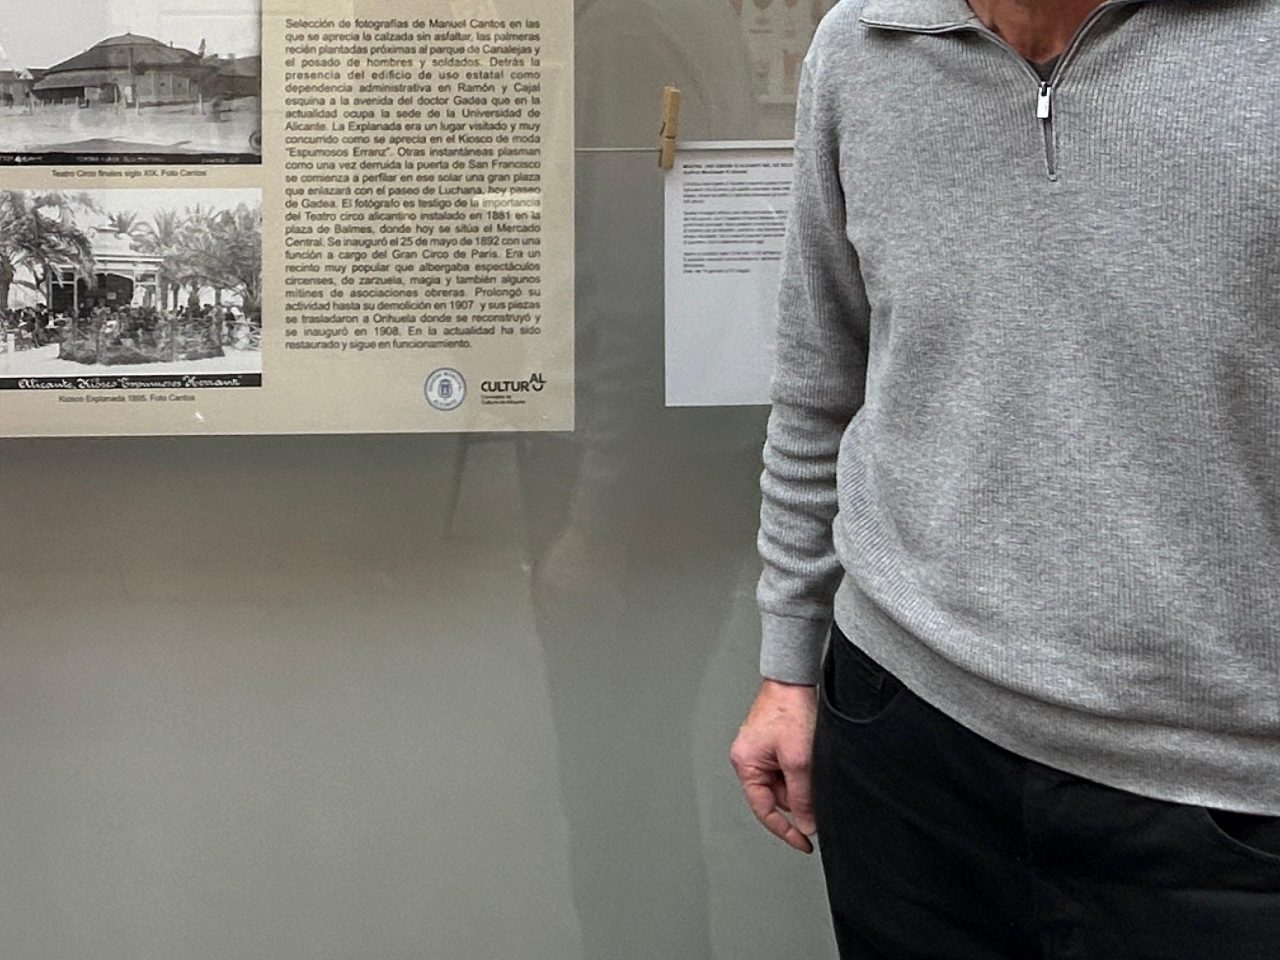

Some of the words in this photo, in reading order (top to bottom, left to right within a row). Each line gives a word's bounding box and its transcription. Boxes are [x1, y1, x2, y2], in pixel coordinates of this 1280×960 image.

[286, 19, 334, 28] Selección
[338, 19, 351, 28] de
[355, 19, 408, 31] fotografías
[412, 19, 425, 28] de
[429, 19, 466, 28] Manuel
[470, 19, 506, 28] Cantos
[525, 19, 540, 28] las
[286, 34, 304, 43] que
[322, 32, 360, 43] aprecia
[362, 32, 372, 41] la
[374, 32, 414, 41] calzada
[416, 32, 431, 41] sin
[476, 32, 491, 41] las
[494, 32, 540, 43] palmeras
[286, 58, 295, 67] el
[301, 58, 340, 69] posado
[346, 58, 360, 67] de
[366, 58, 413, 67] hombres
[419, 59, 426, 69] y
[489, 58, 524, 66] Detrás
[530, 57, 540, 66] la
[286, 71, 340, 82] presencia
[347, 71, 364, 79] del
[371, 70, 412, 79] edificio
[418, 70, 432, 79] de
[466, 70, 504, 79] estatal
[286, 83, 352, 95] dependencia
[359, 83, 431, 92] administrativa
[458, 83, 495, 92] Ramón
[502, 85, 508, 94] y
[513, 83, 540, 94] Cajal
[286, 109, 337, 118] actualidad
[343, 111, 375, 120] ocupa
[381, 109, 390, 118] la
[396, 109, 421, 118] sede
[427, 109, 440, 118] de
[446, 109, 455, 118] la
[462, 109, 522, 117] Universidad
[527, 109, 540, 117] de
[332, 122, 345, 131] La
[348, 122, 402, 133] Explanada
[440, 122, 466, 133] lugar
[469, 121, 507, 130] visitado
[510, 123, 516, 133] y
[519, 123, 540, 133] muy
[286, 134, 338, 143] concurrido
[389, 134, 426, 145] aprecia
[446, 134, 455, 143] el
[458, 134, 493, 143] Kiosco
[496, 134, 509, 143] de
[512, 134, 540, 143] moda
[338, 161, 356, 169] vez
[360, 160, 401, 168] derruida
[404, 160, 414, 168] la
[417, 160, 449, 171] puerta
[452, 159, 465, 168] de
[468, 159, 488, 168] San
[492, 159, 540, 168] Francisco
[286, 211, 300, 220] del
[305, 211, 336, 220] Teatro
[340, 211, 364, 220] circo
[368, 211, 416, 220] alicantino
[420, 211, 466, 219] instalado
[486, 210, 510, 219] 1881
[531, 210, 540, 219] la
[286, 262, 320, 271] recinto
[325, 264, 346, 273] muy
[352, 262, 390, 273] popular
[394, 264, 414, 273] que
[419, 262, 469, 273] albergaba
[475, 262, 540, 273] espectáculos
[341, 275, 354, 284] de
[410, 275, 440, 286] magia
[445, 277, 452, 286] y
[456, 275, 496, 284] también
[501, 275, 540, 286] algunos
